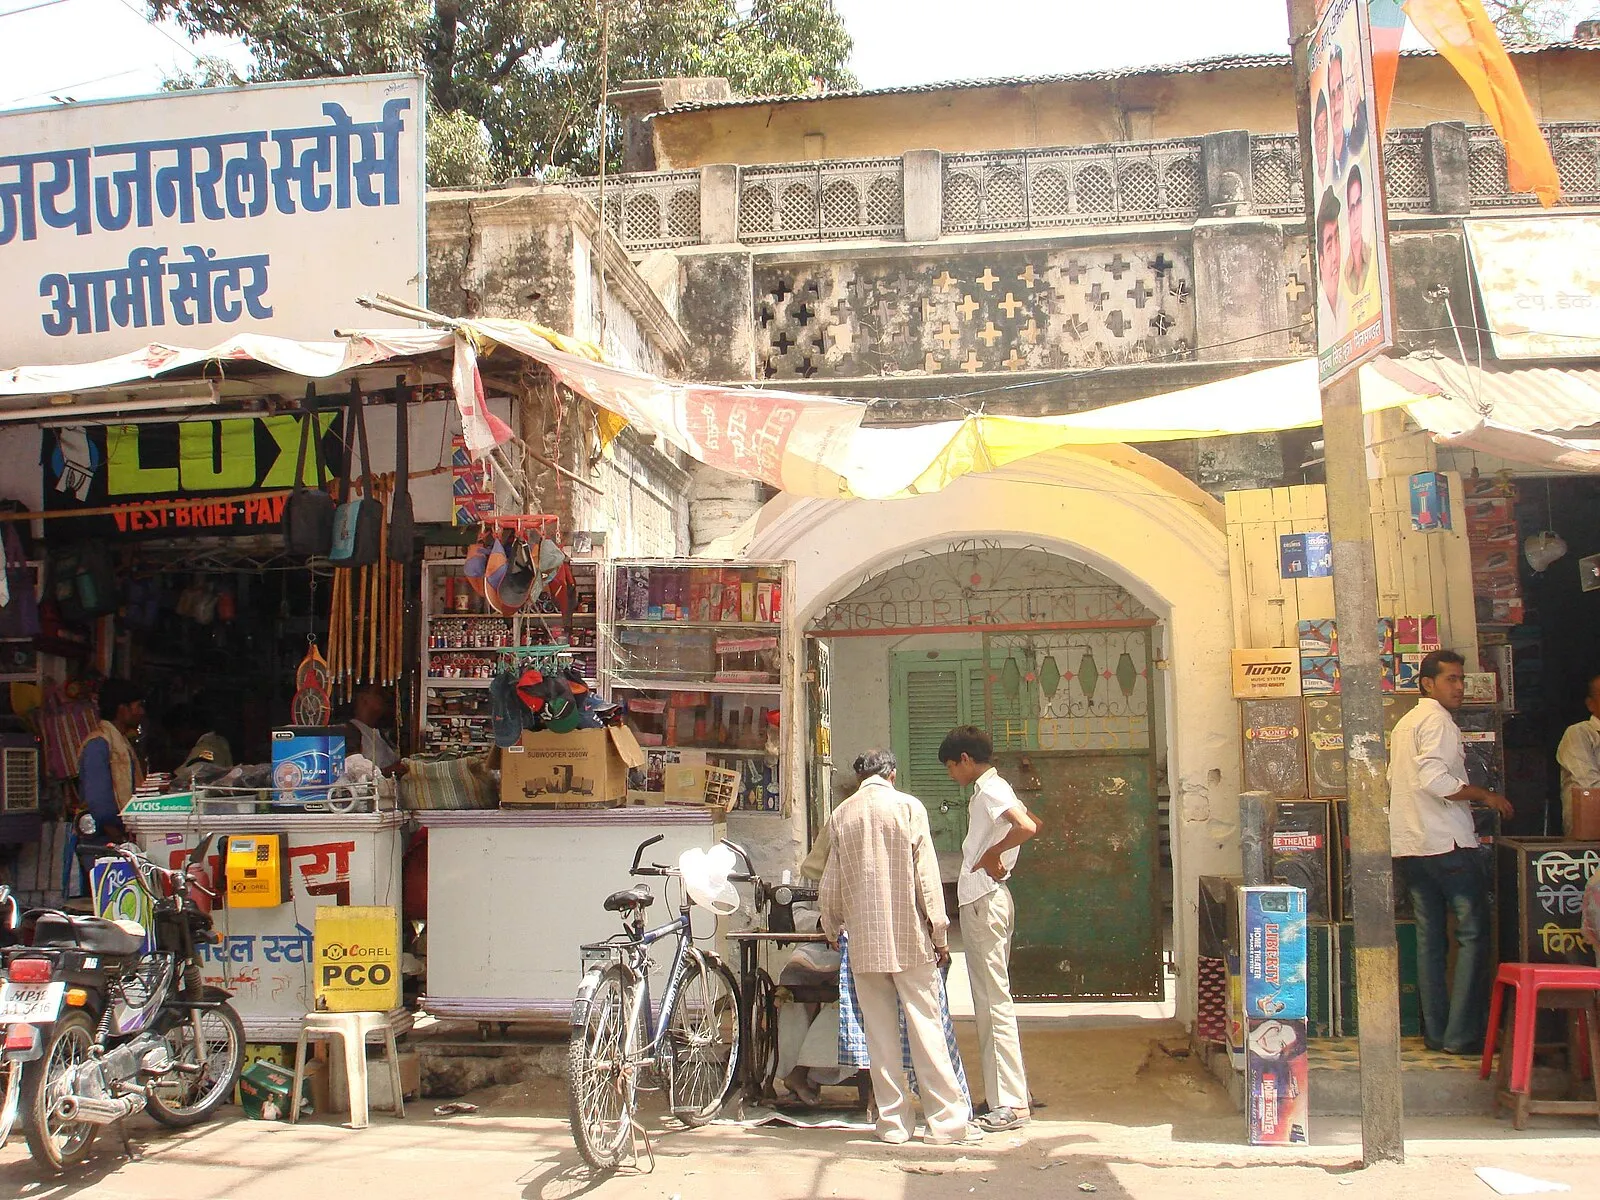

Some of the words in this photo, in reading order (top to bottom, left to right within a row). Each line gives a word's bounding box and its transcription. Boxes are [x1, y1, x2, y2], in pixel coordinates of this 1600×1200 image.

[106, 412, 340, 495] LUX
[1241, 662, 1292, 676] Turbo
[1005, 717, 1145, 749] HOUSE
[527, 751, 567, 759] SUBWOOFER
[1284, 835, 1317, 847] THEATER
[1253, 927, 1262, 949] HOME
[1253, 950, 1262, 979] THEATER
[1264, 923, 1280, 985] LIBERTY
[322, 965, 391, 987] PCO
[1263, 1079, 1274, 1101] HOME
[1264, 1102, 1275, 1135] THEATER
